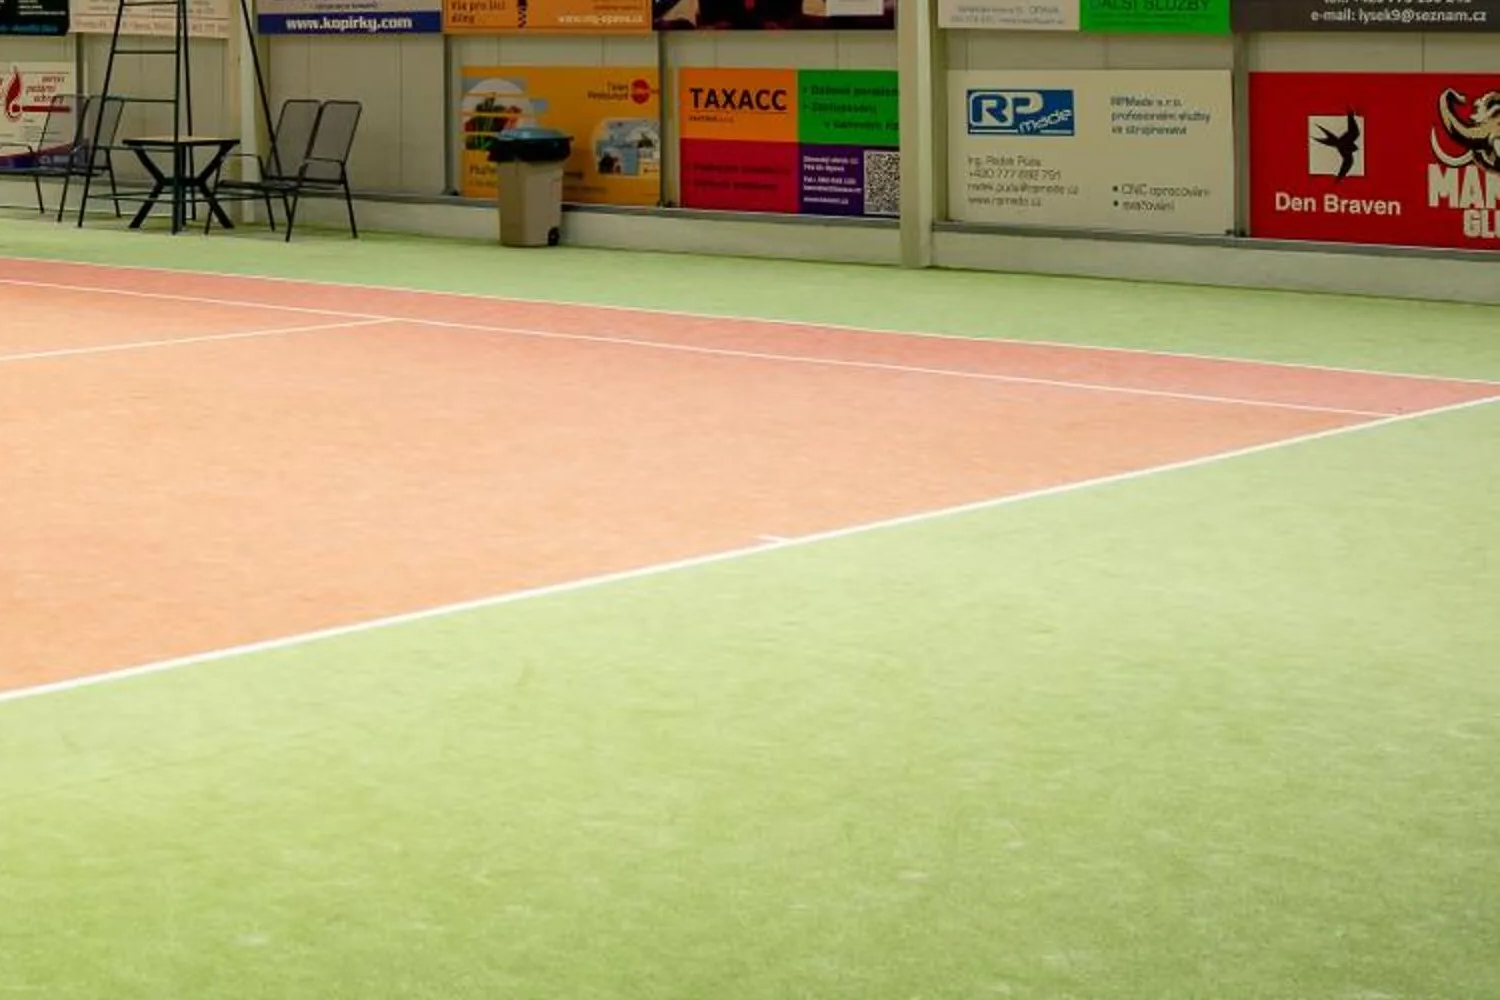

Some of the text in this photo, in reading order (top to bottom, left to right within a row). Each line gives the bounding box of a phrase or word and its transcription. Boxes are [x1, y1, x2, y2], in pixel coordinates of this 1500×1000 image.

[1310, 10, 1355, 21] e-mail:
[689, 87, 788, 112] TAXACC
[1275, 192, 1401, 216] Den Braven
